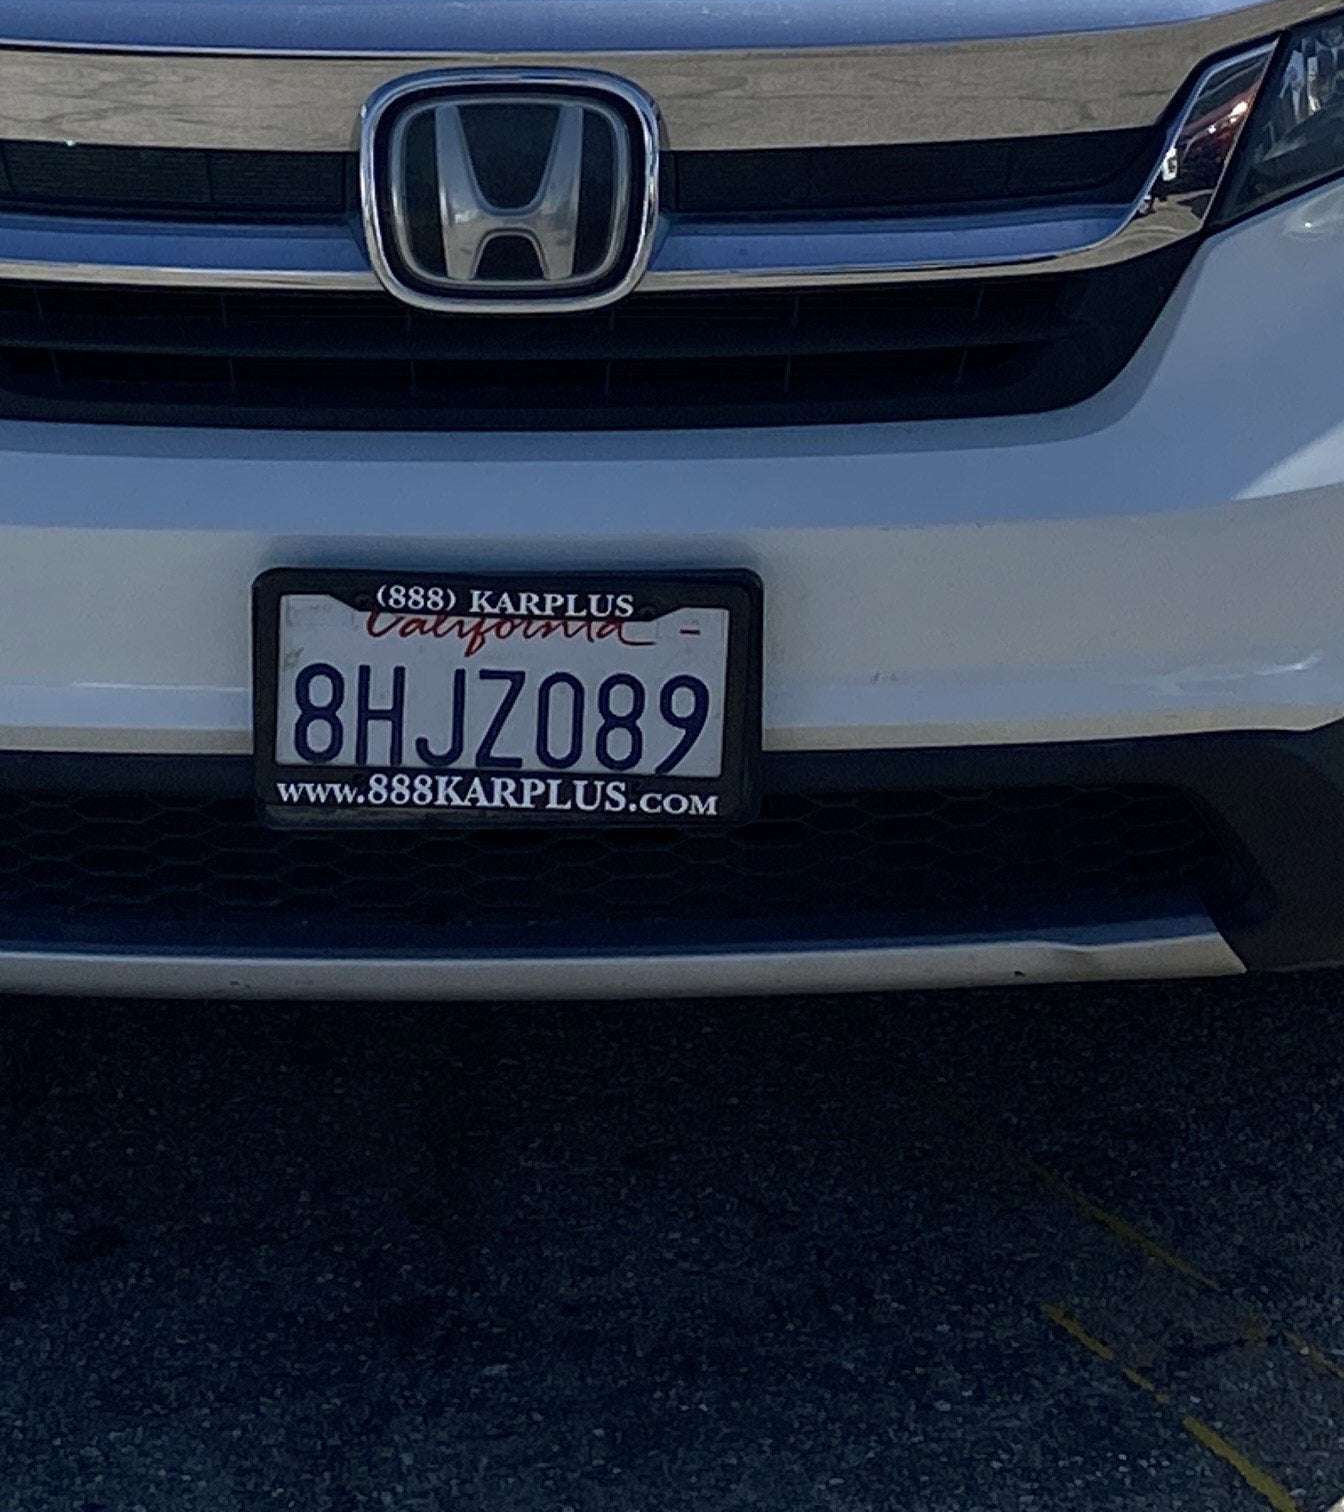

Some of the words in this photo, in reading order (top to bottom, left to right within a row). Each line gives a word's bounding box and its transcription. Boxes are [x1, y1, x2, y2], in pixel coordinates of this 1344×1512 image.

[376, 584, 456, 611] (888)
[469, 590, 634, 618] KARPLUS
[293, 662, 710, 776] 8HJZ089
